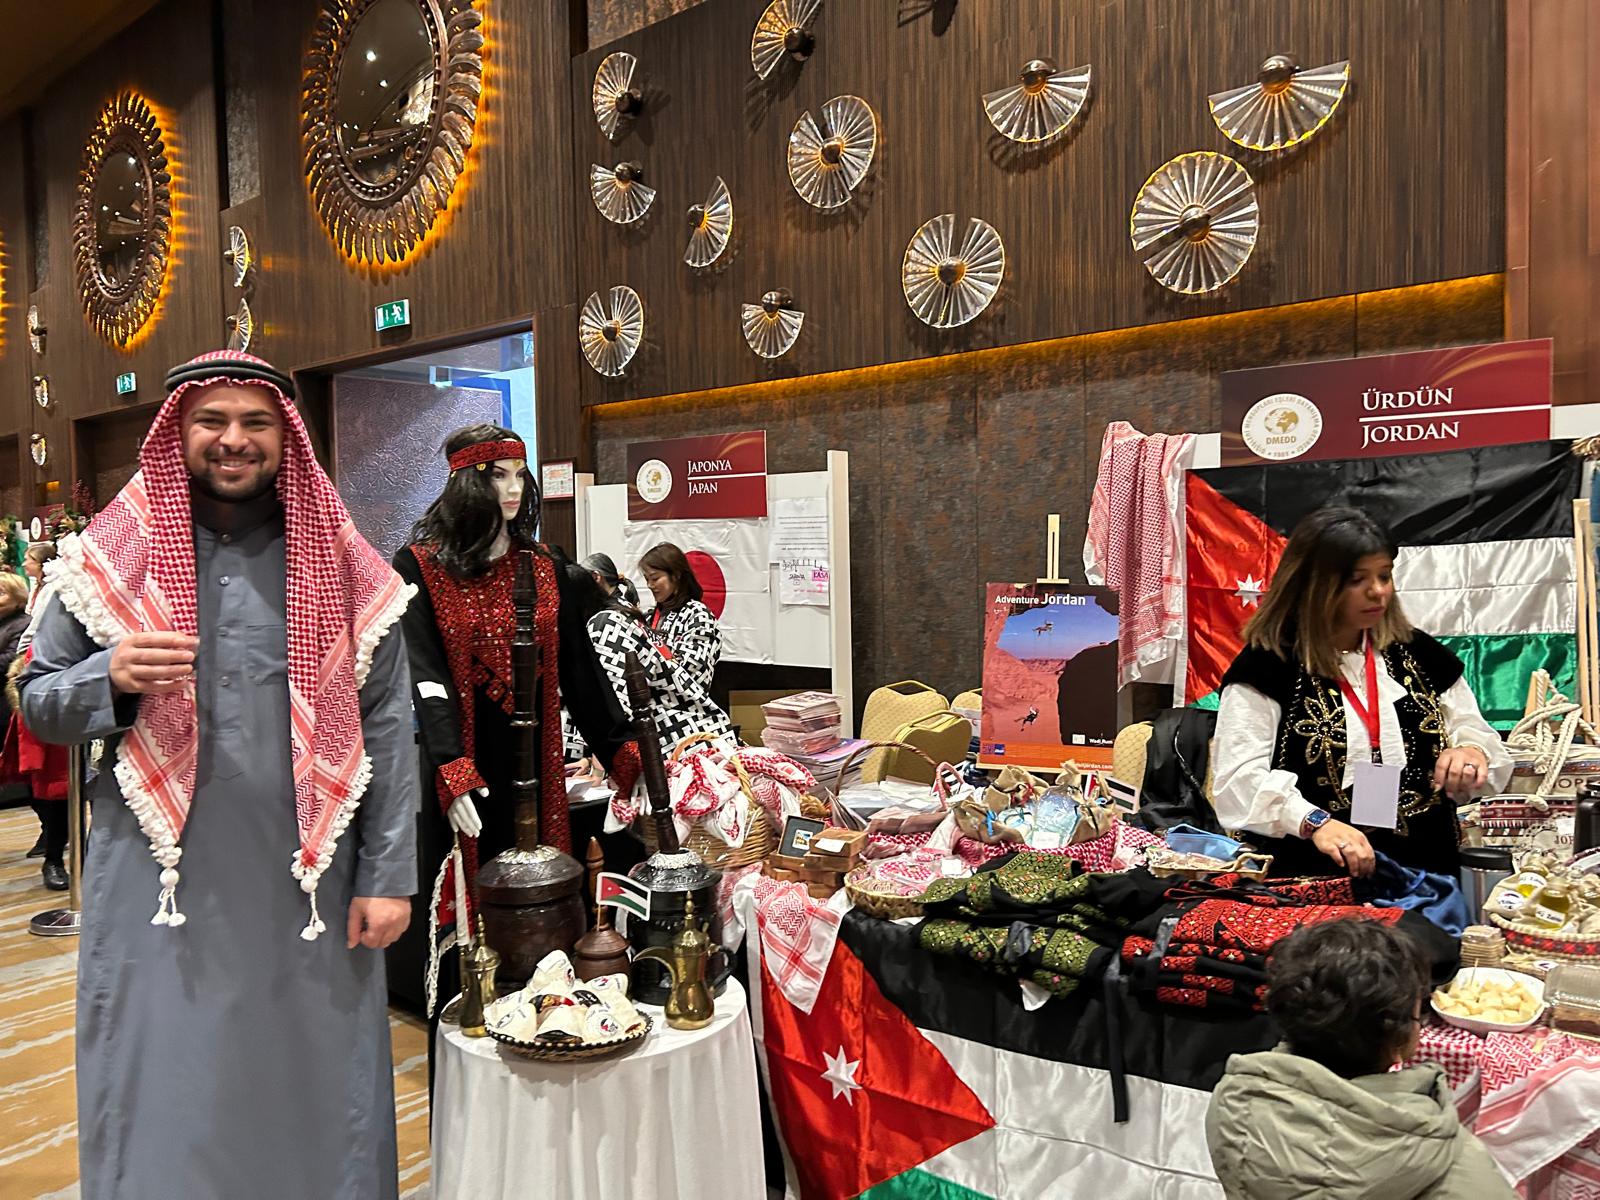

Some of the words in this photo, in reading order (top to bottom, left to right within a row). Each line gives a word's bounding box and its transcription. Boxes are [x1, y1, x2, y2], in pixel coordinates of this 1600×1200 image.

[1361, 386, 1454, 411] ÜRDÜN
[1266, 436, 1297, 445] DMEDD
[1360, 421, 1460, 449] JORDAN
[687, 459, 733, 476] JAPONYA
[688, 482, 718, 498] JAPAN
[995, 595, 1040, 604] Adventure
[1041, 593, 1086, 605] Jordan
